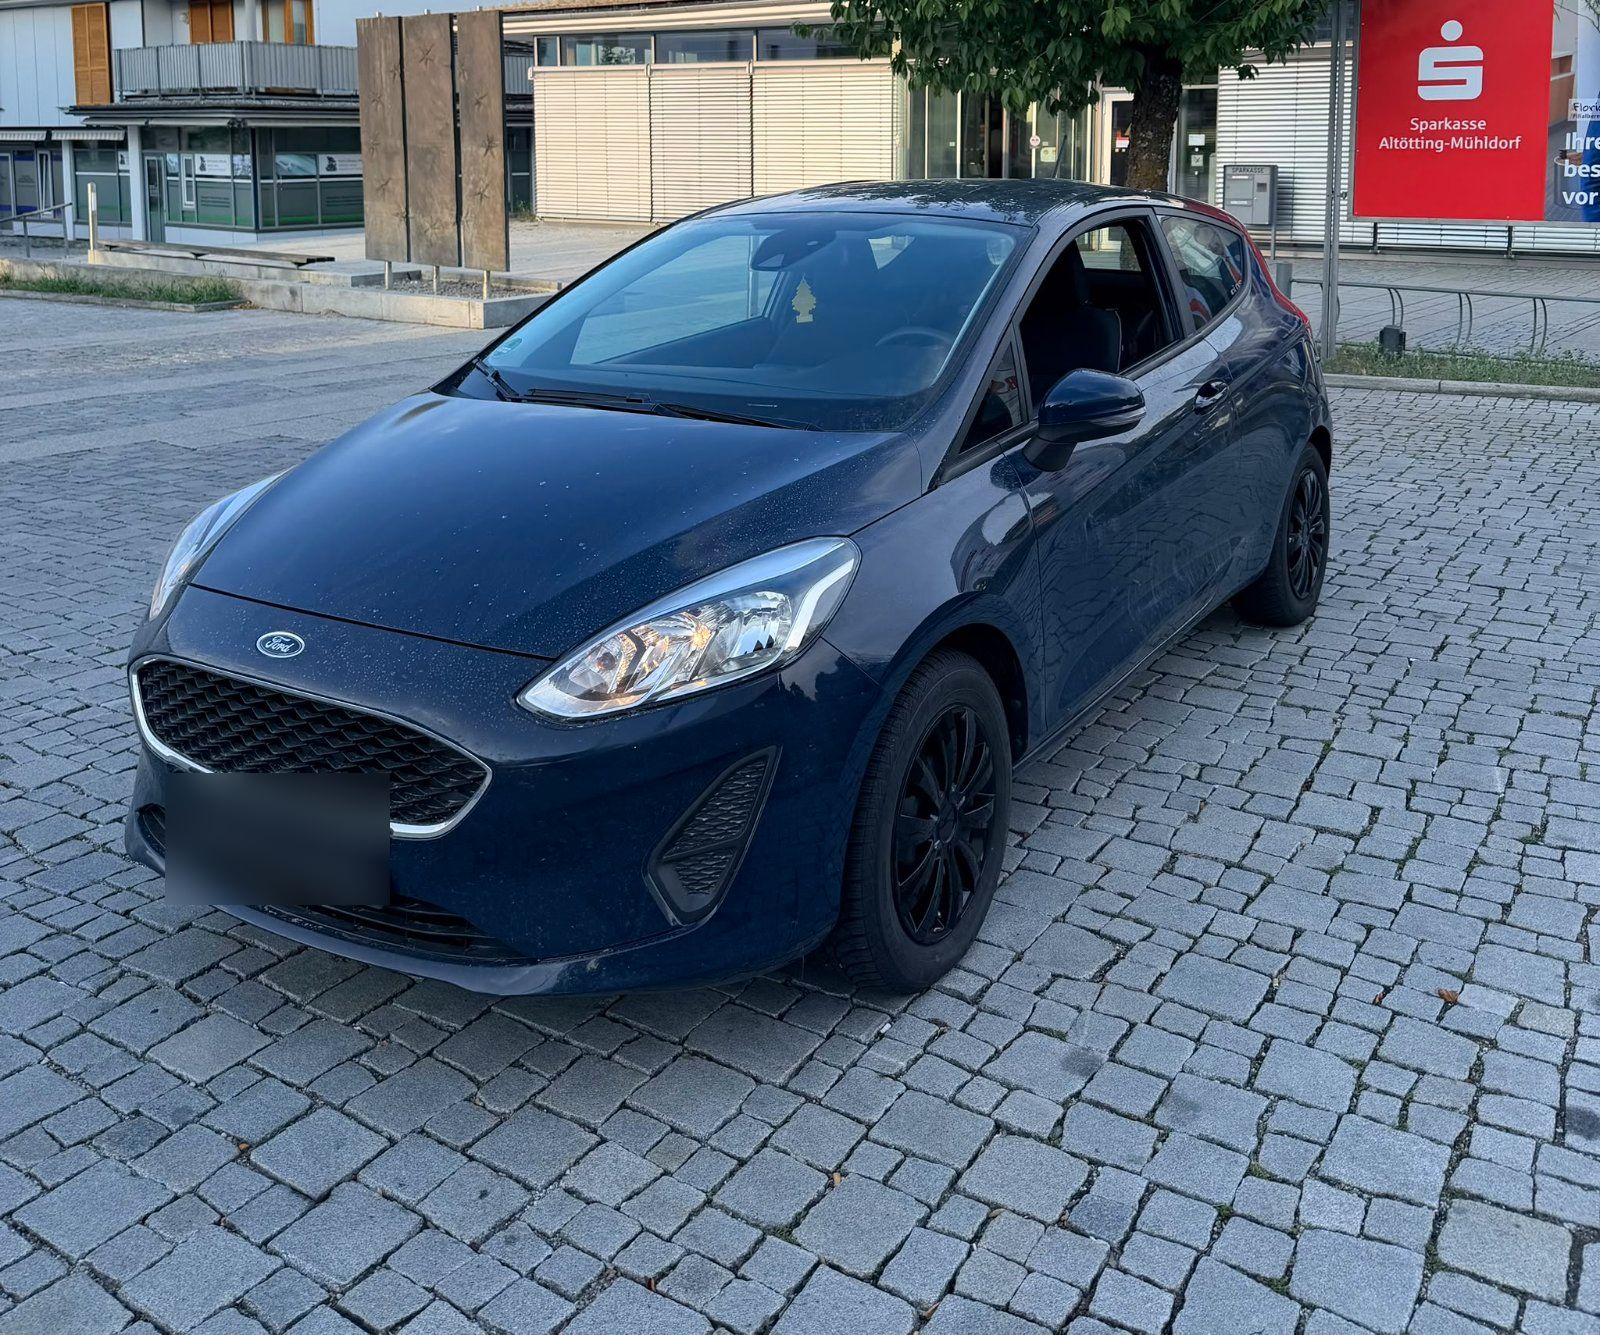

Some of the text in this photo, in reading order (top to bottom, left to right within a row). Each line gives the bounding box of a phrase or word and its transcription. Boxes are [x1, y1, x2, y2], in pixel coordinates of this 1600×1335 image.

[1410, 117, 1487, 133] Sparkasse
[1378, 135, 1522, 152] Altötting-Mühldorf
[1565, 132, 1600, 150] Ihre
[1563, 159, 1600, 178] bes
[1562, 191, 1599, 205] vor
[265, 635, 295, 653] Ford
